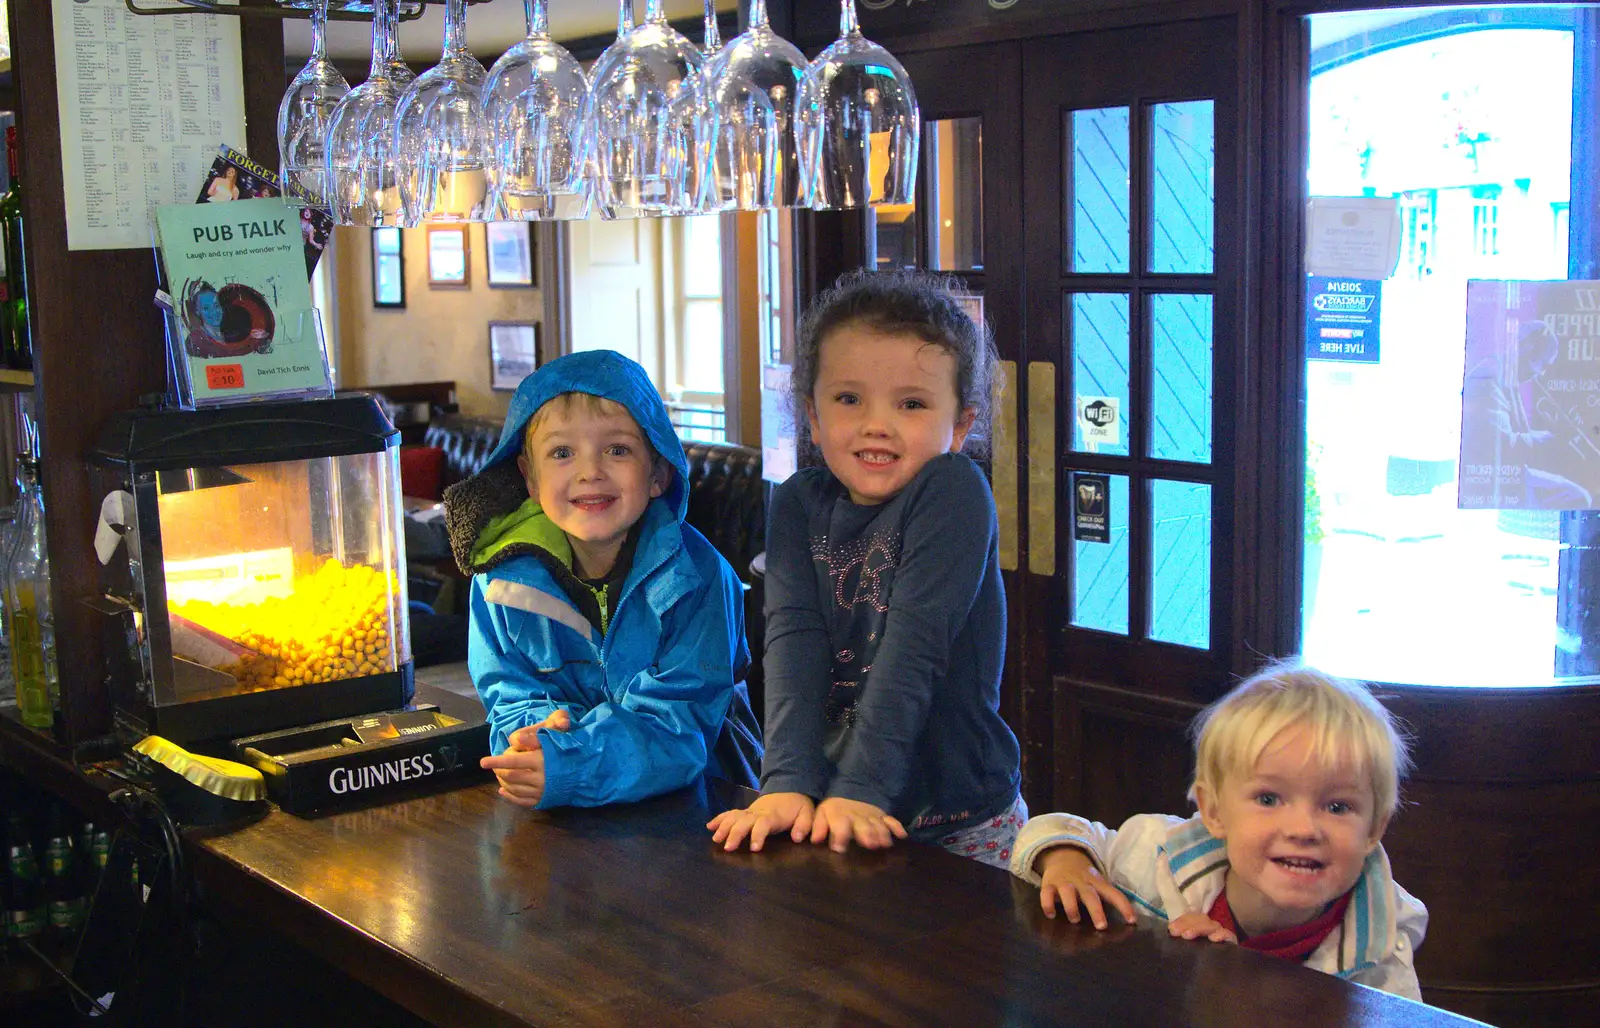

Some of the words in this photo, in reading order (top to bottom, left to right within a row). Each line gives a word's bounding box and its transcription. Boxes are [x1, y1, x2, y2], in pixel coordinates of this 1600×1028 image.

[227, 149, 280, 185] FORGET
[193, 225, 233, 243] PUB
[238, 219, 287, 239] TALK
[186, 251, 207, 260] Laugh
[222, 250, 233, 259] cry
[234, 248, 248, 256] and
[249, 246, 275, 254] wonder
[277, 244, 292, 253] why
[257, 368, 276, 376] David
[293, 365, 310, 373] Ennis
[1089, 428, 1108, 436] ZONE
[329, 753, 434, 795] GUINNESS
